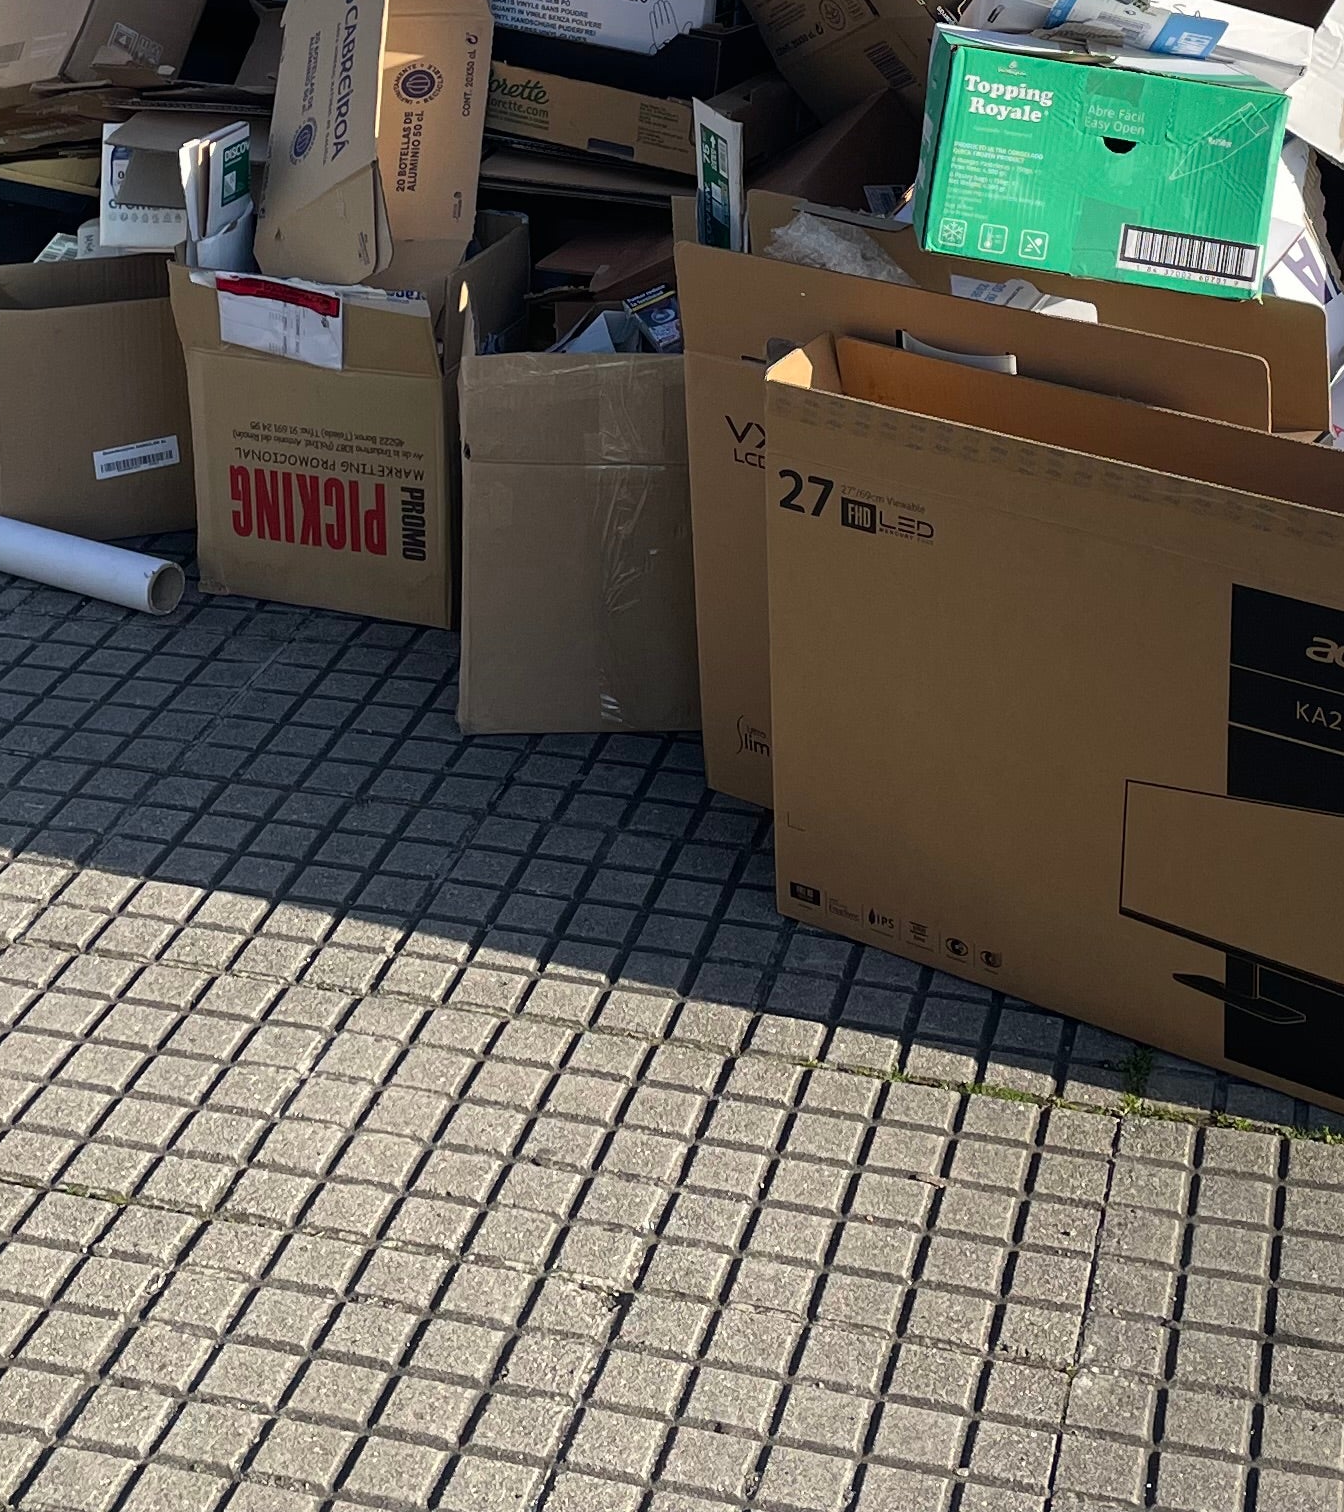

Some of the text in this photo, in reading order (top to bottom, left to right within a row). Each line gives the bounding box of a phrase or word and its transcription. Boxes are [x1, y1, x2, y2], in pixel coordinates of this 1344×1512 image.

[465, 60, 476, 89] 20X50
[462, 89, 471, 117] CONT.
[965, 74, 1054, 107] Topping
[490, 97, 549, 118] orette.com
[969, 96, 1042, 123] Royale
[1088, 105, 1145, 123] Abre Fácil
[1084, 117, 1145, 136] Easy Open
[396, 111, 414, 192] 20 BOTELLAS DE
[406, 139, 421, 192] ALUMINIO
[415, 123, 422, 137] 50
[235, 447, 425, 481] MARKETING PROMOCIONAL
[778, 469, 834, 517] 27
[229, 464, 387, 556] PICKING
[401, 486, 426, 562] PROMO
[847, 503, 871, 528] FHD
[879, 510, 934, 539] LED
[1295, 700, 1342, 731] KA2
[877, 914, 895, 930] IPS
